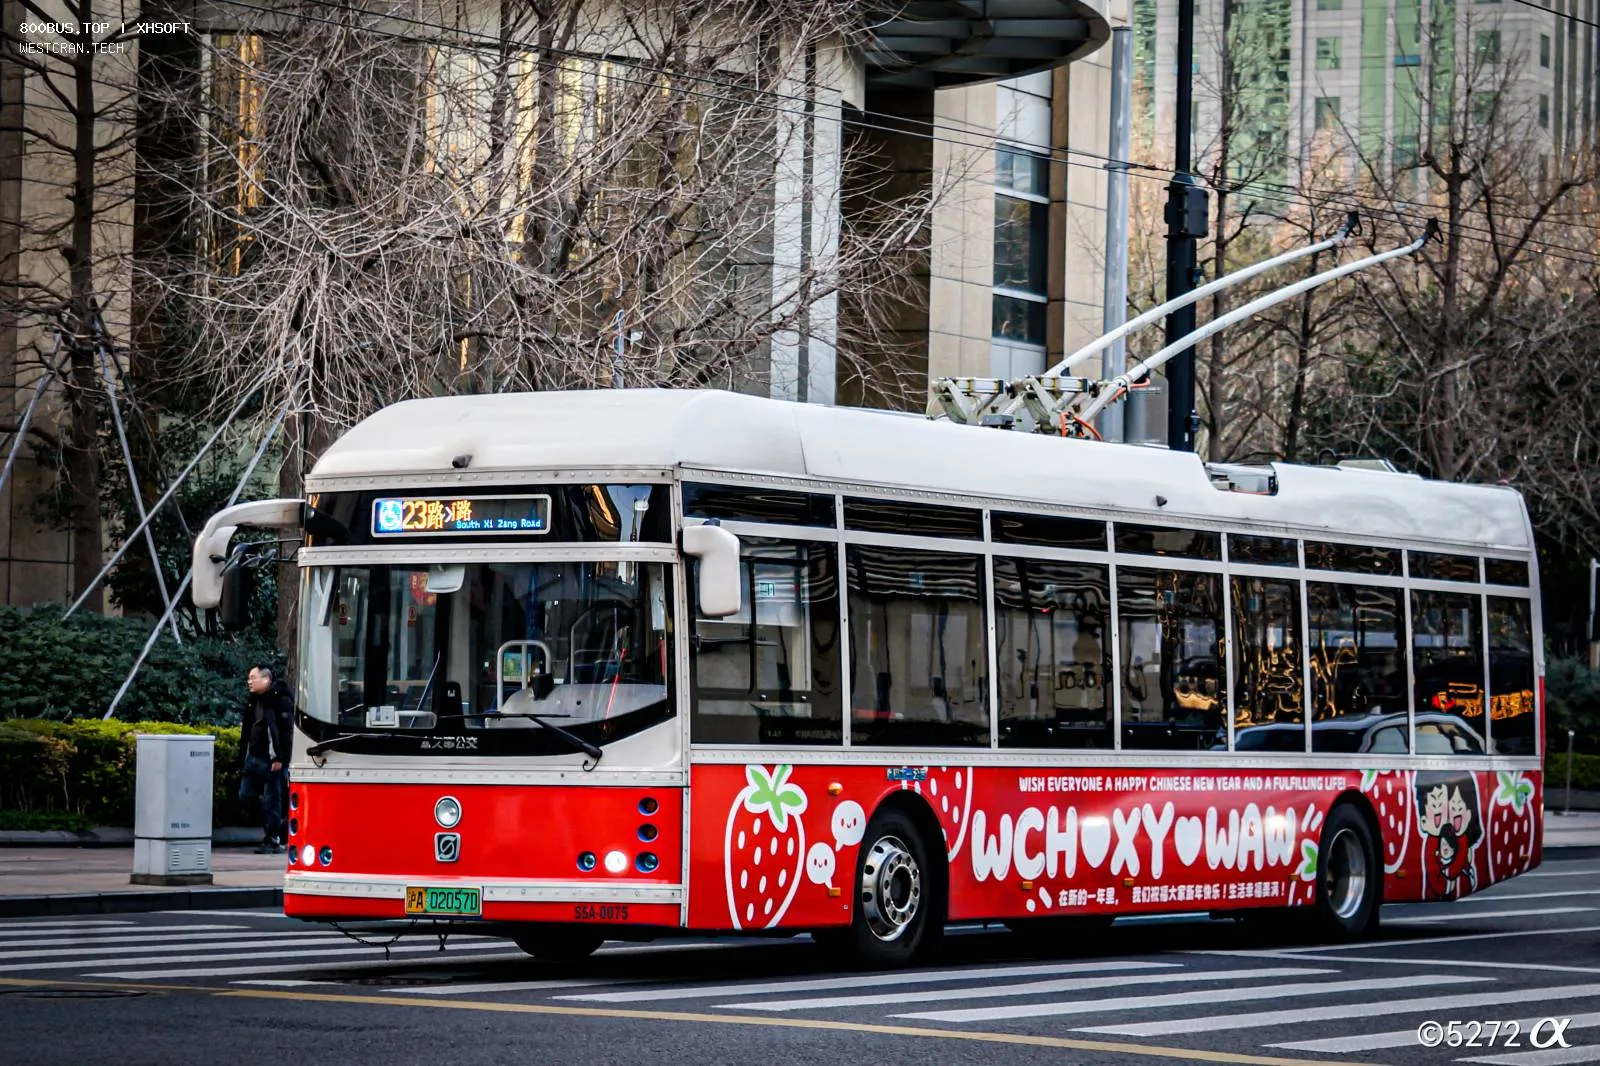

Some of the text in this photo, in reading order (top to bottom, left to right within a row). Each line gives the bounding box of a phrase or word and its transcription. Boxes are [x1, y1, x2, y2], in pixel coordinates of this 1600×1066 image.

[402, 500, 446, 530] 23路
[455, 518, 541, 530] South Xi Zang Road
[1018, 776, 1346, 792] WISH EVERYONE A HAPPY CHINESE NEW YEAR AND A FULFILLING LIFE!
